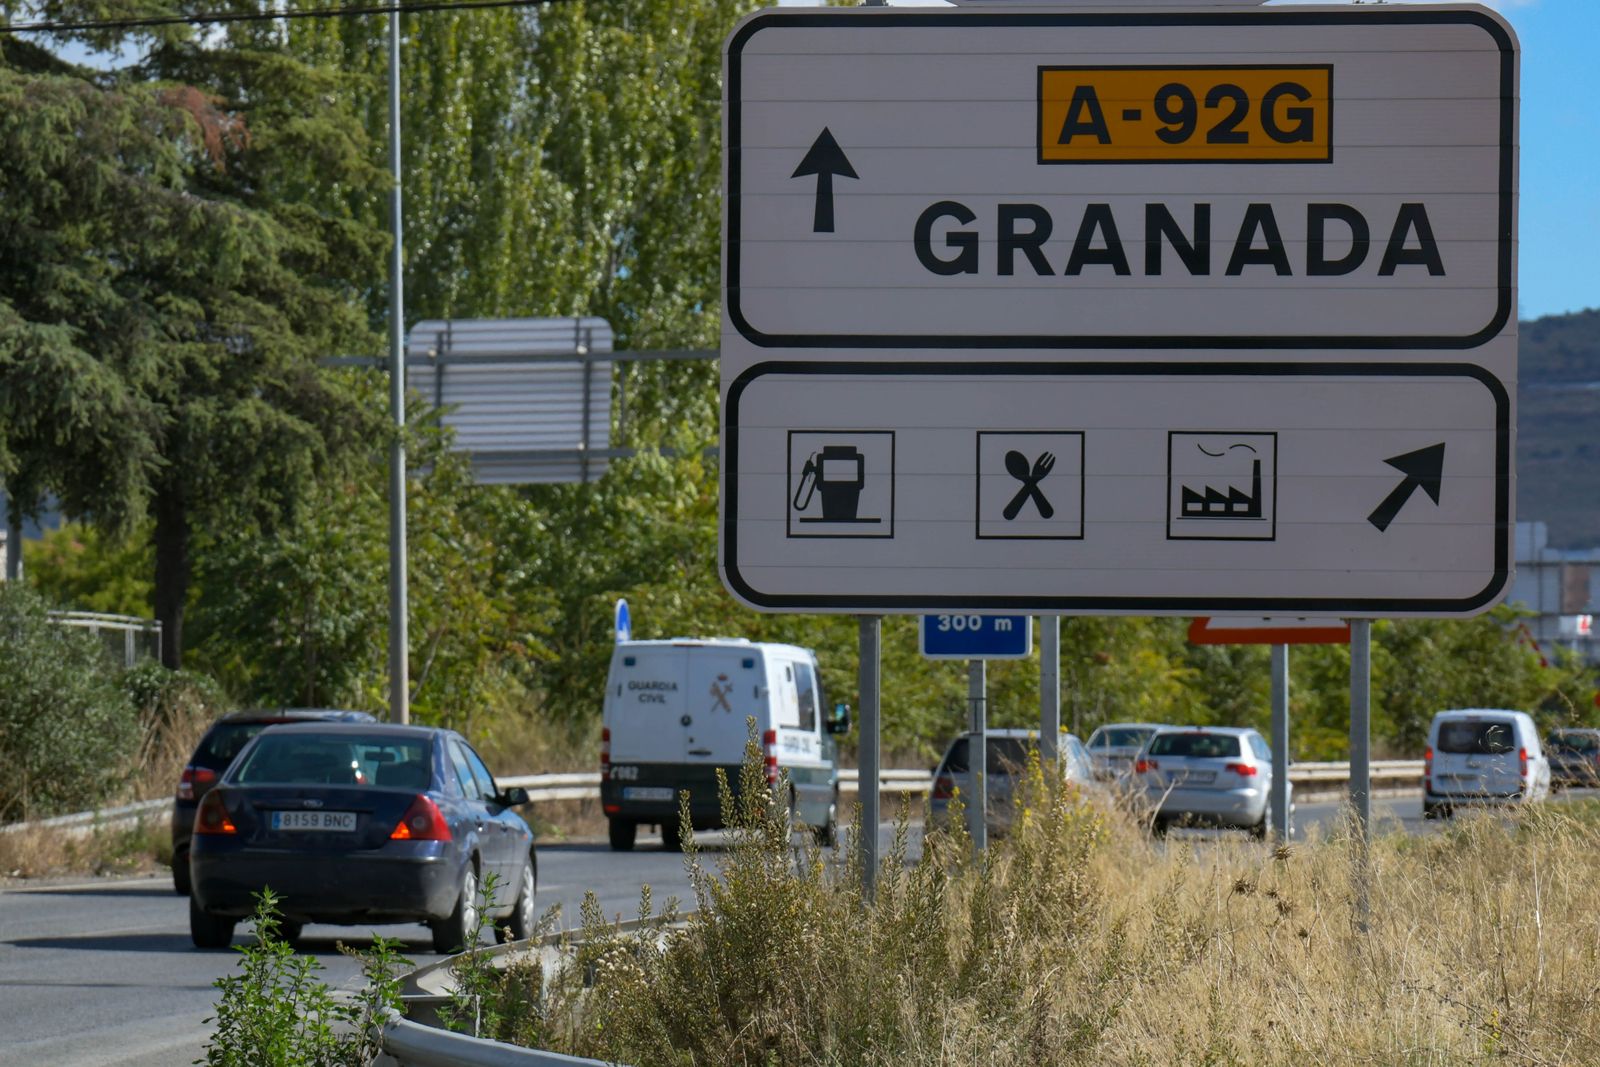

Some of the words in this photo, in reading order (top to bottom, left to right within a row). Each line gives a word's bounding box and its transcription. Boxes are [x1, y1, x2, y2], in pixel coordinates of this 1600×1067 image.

[1057, 82, 1315, 146] A-92G
[913, 200, 1447, 277] GRANADA
[938, 615, 982, 631] 300
[994, 618, 1012, 631] m
[628, 681, 678, 692] GUARDIA
[638, 693, 666, 704] CIVIL
[283, 813, 319, 826] 8159
[324, 814, 350, 827] BNC
